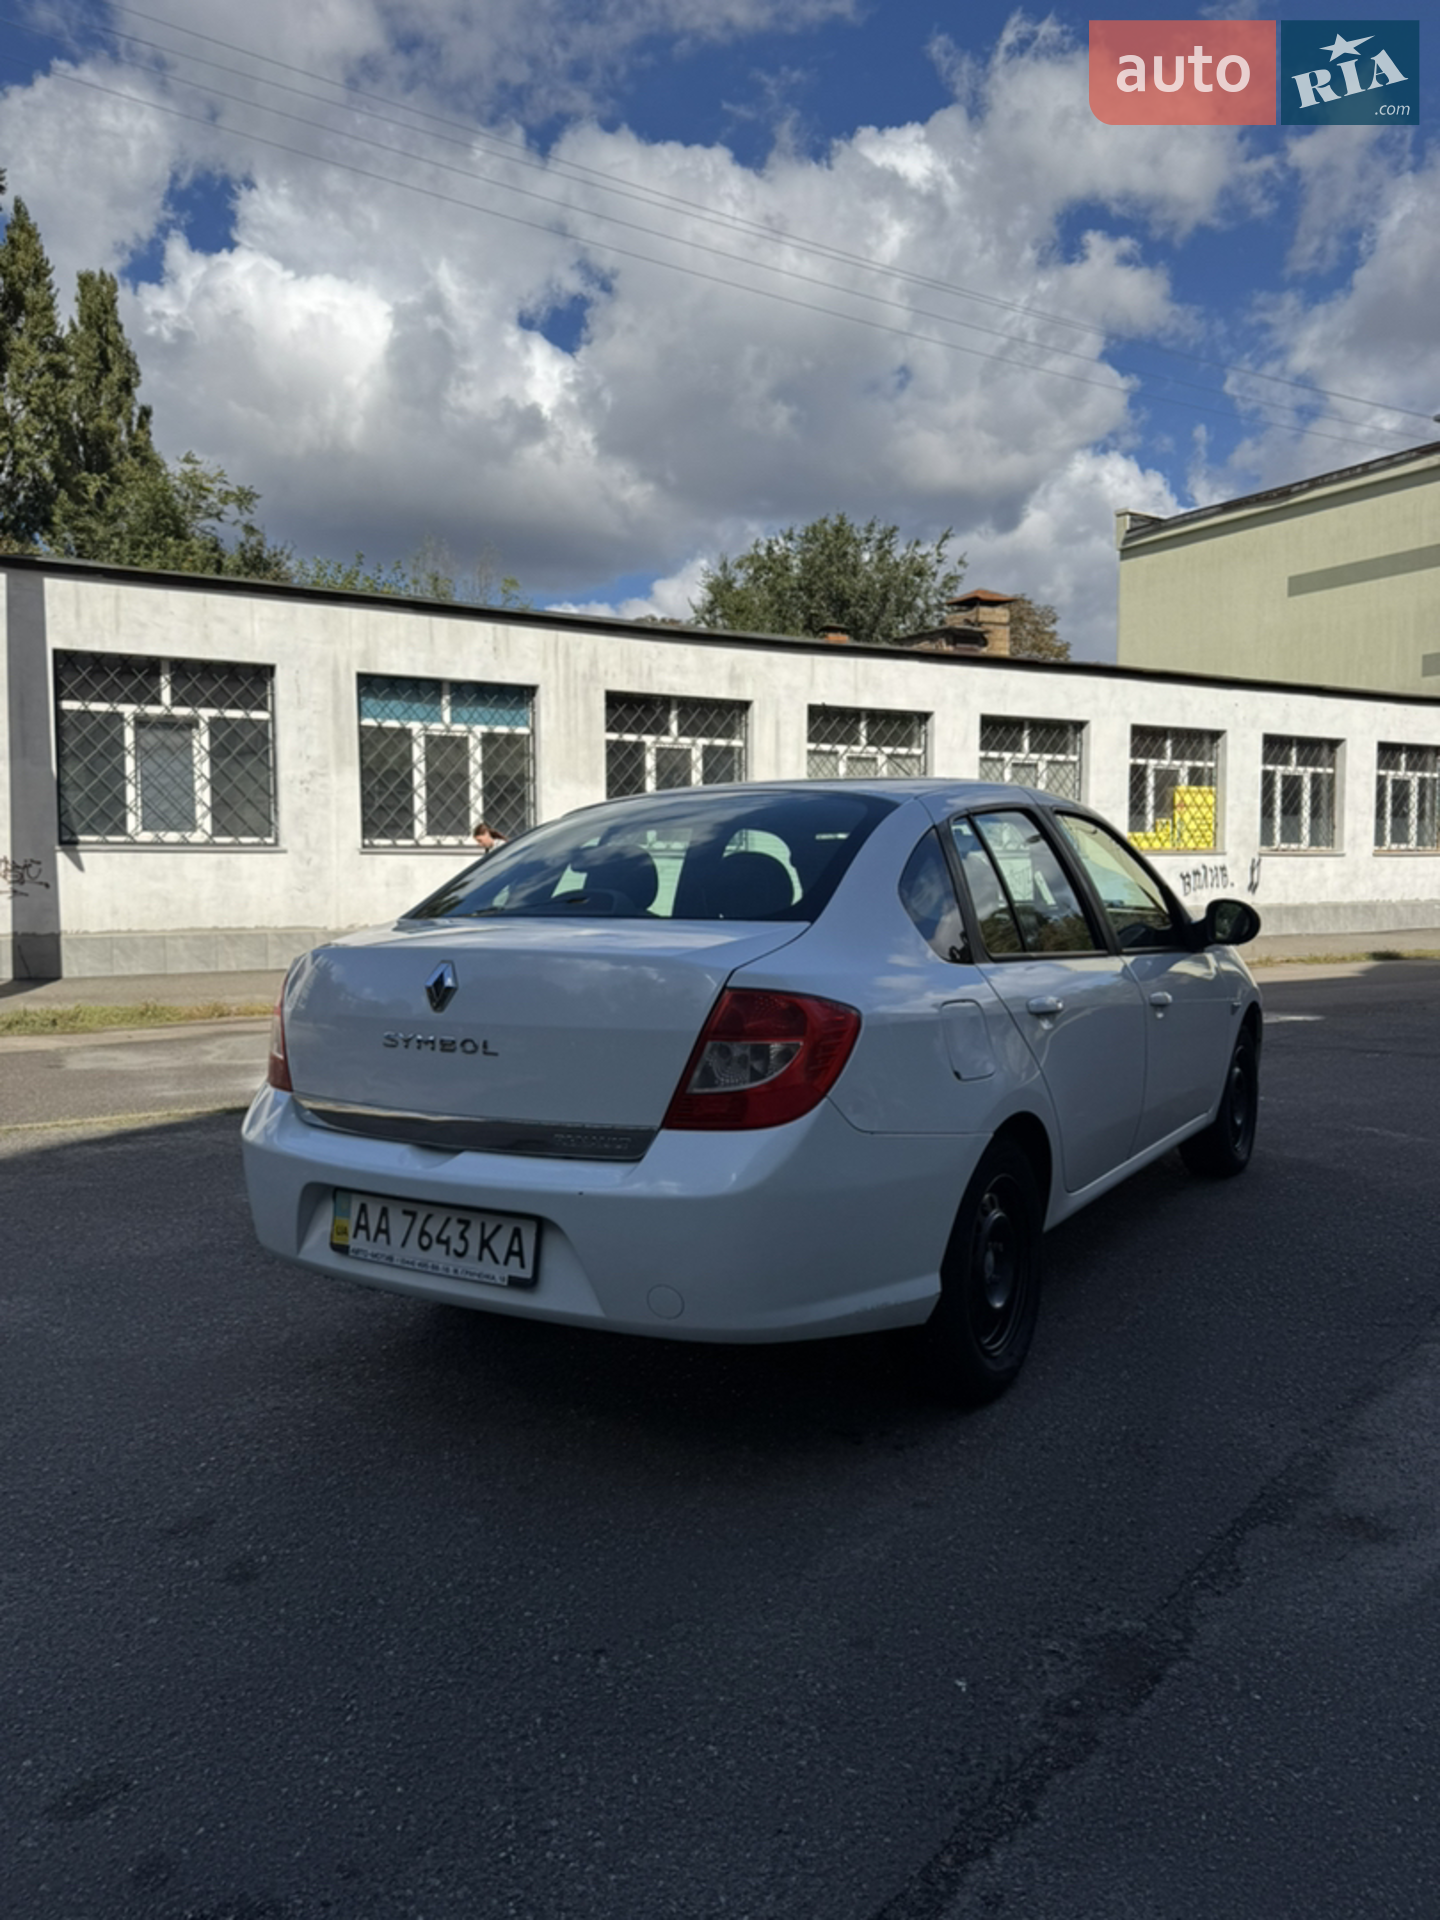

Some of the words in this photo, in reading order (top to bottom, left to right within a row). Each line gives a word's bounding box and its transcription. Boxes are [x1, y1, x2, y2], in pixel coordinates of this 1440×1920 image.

[382, 1031, 499, 1057] SYMBOL
[353, 1203, 391, 1246] AA
[400, 1209, 471, 1258] 7643
[478, 1221, 526, 1269] KA
